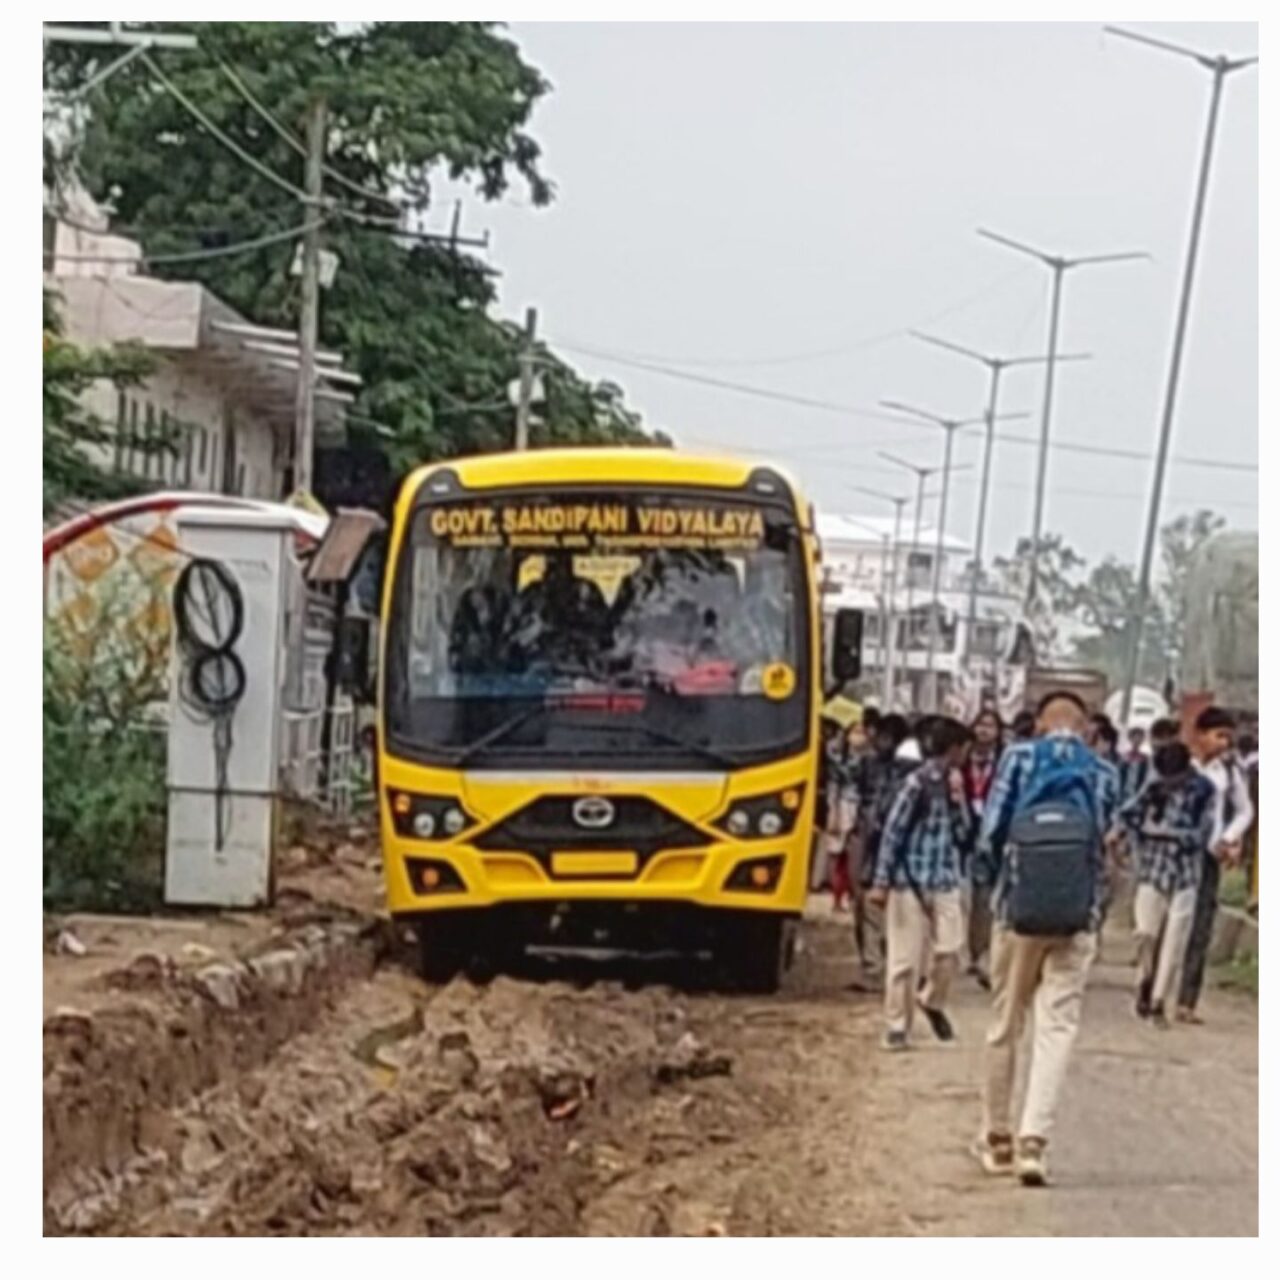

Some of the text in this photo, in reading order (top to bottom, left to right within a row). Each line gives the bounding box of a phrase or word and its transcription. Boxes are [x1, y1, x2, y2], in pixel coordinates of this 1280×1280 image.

[431, 506, 765, 537] GOVT. SANDIPANI VIDYALAYA
